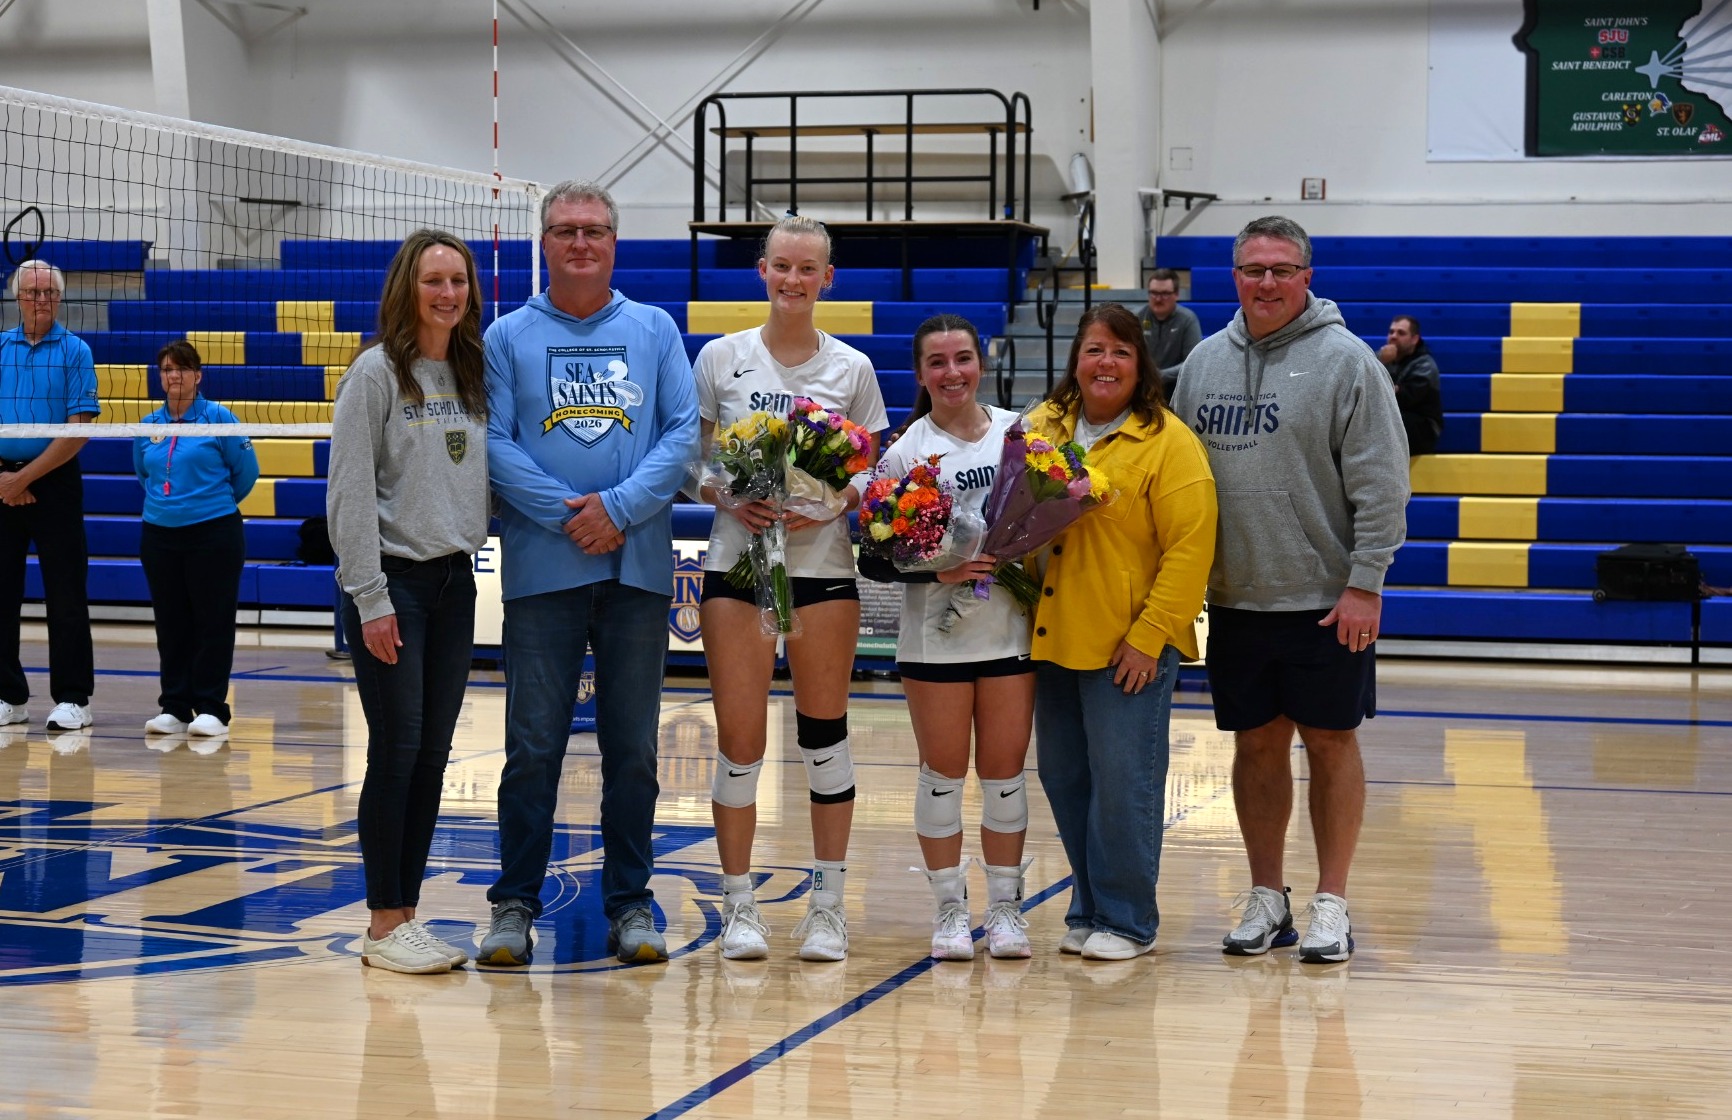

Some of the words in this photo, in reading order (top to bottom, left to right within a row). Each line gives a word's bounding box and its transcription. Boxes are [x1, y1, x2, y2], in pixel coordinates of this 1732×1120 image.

[1584, 17, 1613, 27] SAINT
[1614, 16, 1649, 28] JOHN'S
[1599, 28, 1629, 44] SJU
[1602, 46, 1626, 59] CSB
[1551, 61, 1581, 71] SAINT
[1582, 61, 1632, 71] BENEDICT
[1602, 92, 1653, 101] CARLETON
[1573, 112, 1622, 122] GUSTAVUS
[1570, 122, 1624, 132] ADULPHUS
[1656, 126, 1671, 137] ST.
[1671, 126, 1699, 137] OLAF
[565, 362, 596, 384] SEA
[558, 381, 617, 407] SAINTS
[1218, 392, 1277, 401] SCHOLATICA
[403, 405, 424, 420] ST.
[555, 409, 620, 419] HOMECOMING
[574, 419, 602, 429] 2026
[1208, 440, 1259, 452] VOLLEYBALL
[955, 465, 998, 491] SAIN
